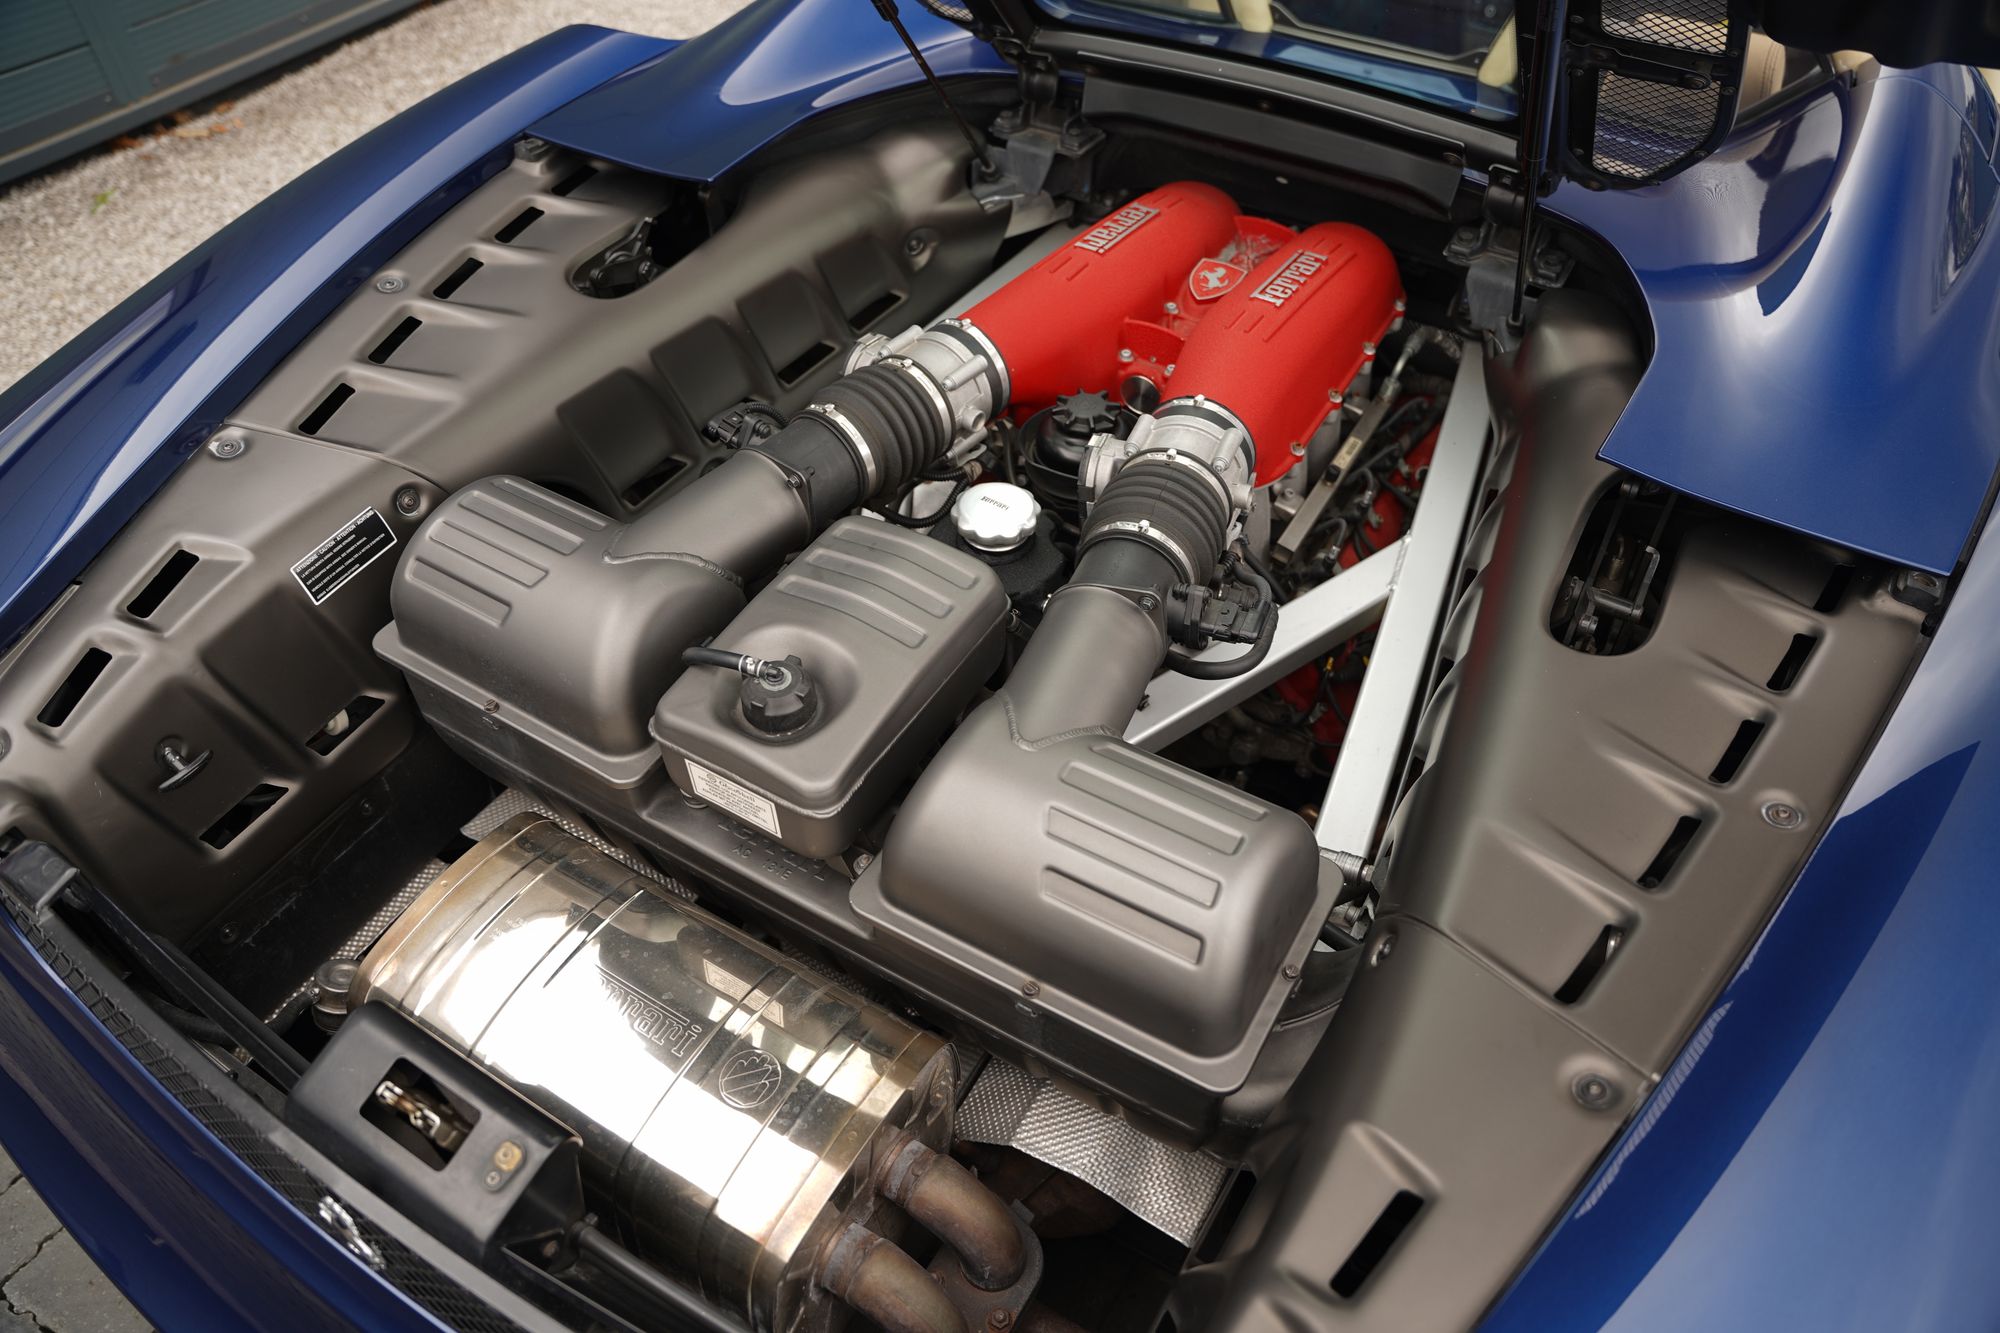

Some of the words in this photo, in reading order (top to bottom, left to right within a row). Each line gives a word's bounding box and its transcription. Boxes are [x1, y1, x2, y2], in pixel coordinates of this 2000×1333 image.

[1074, 203, 1160, 253] Ferrari
[1250, 249, 1328, 307] Ferrari
[981, 496, 1009, 510] Ferrari
[732, 844, 753, 859] AC
[594, 963, 703, 1058] rrari
